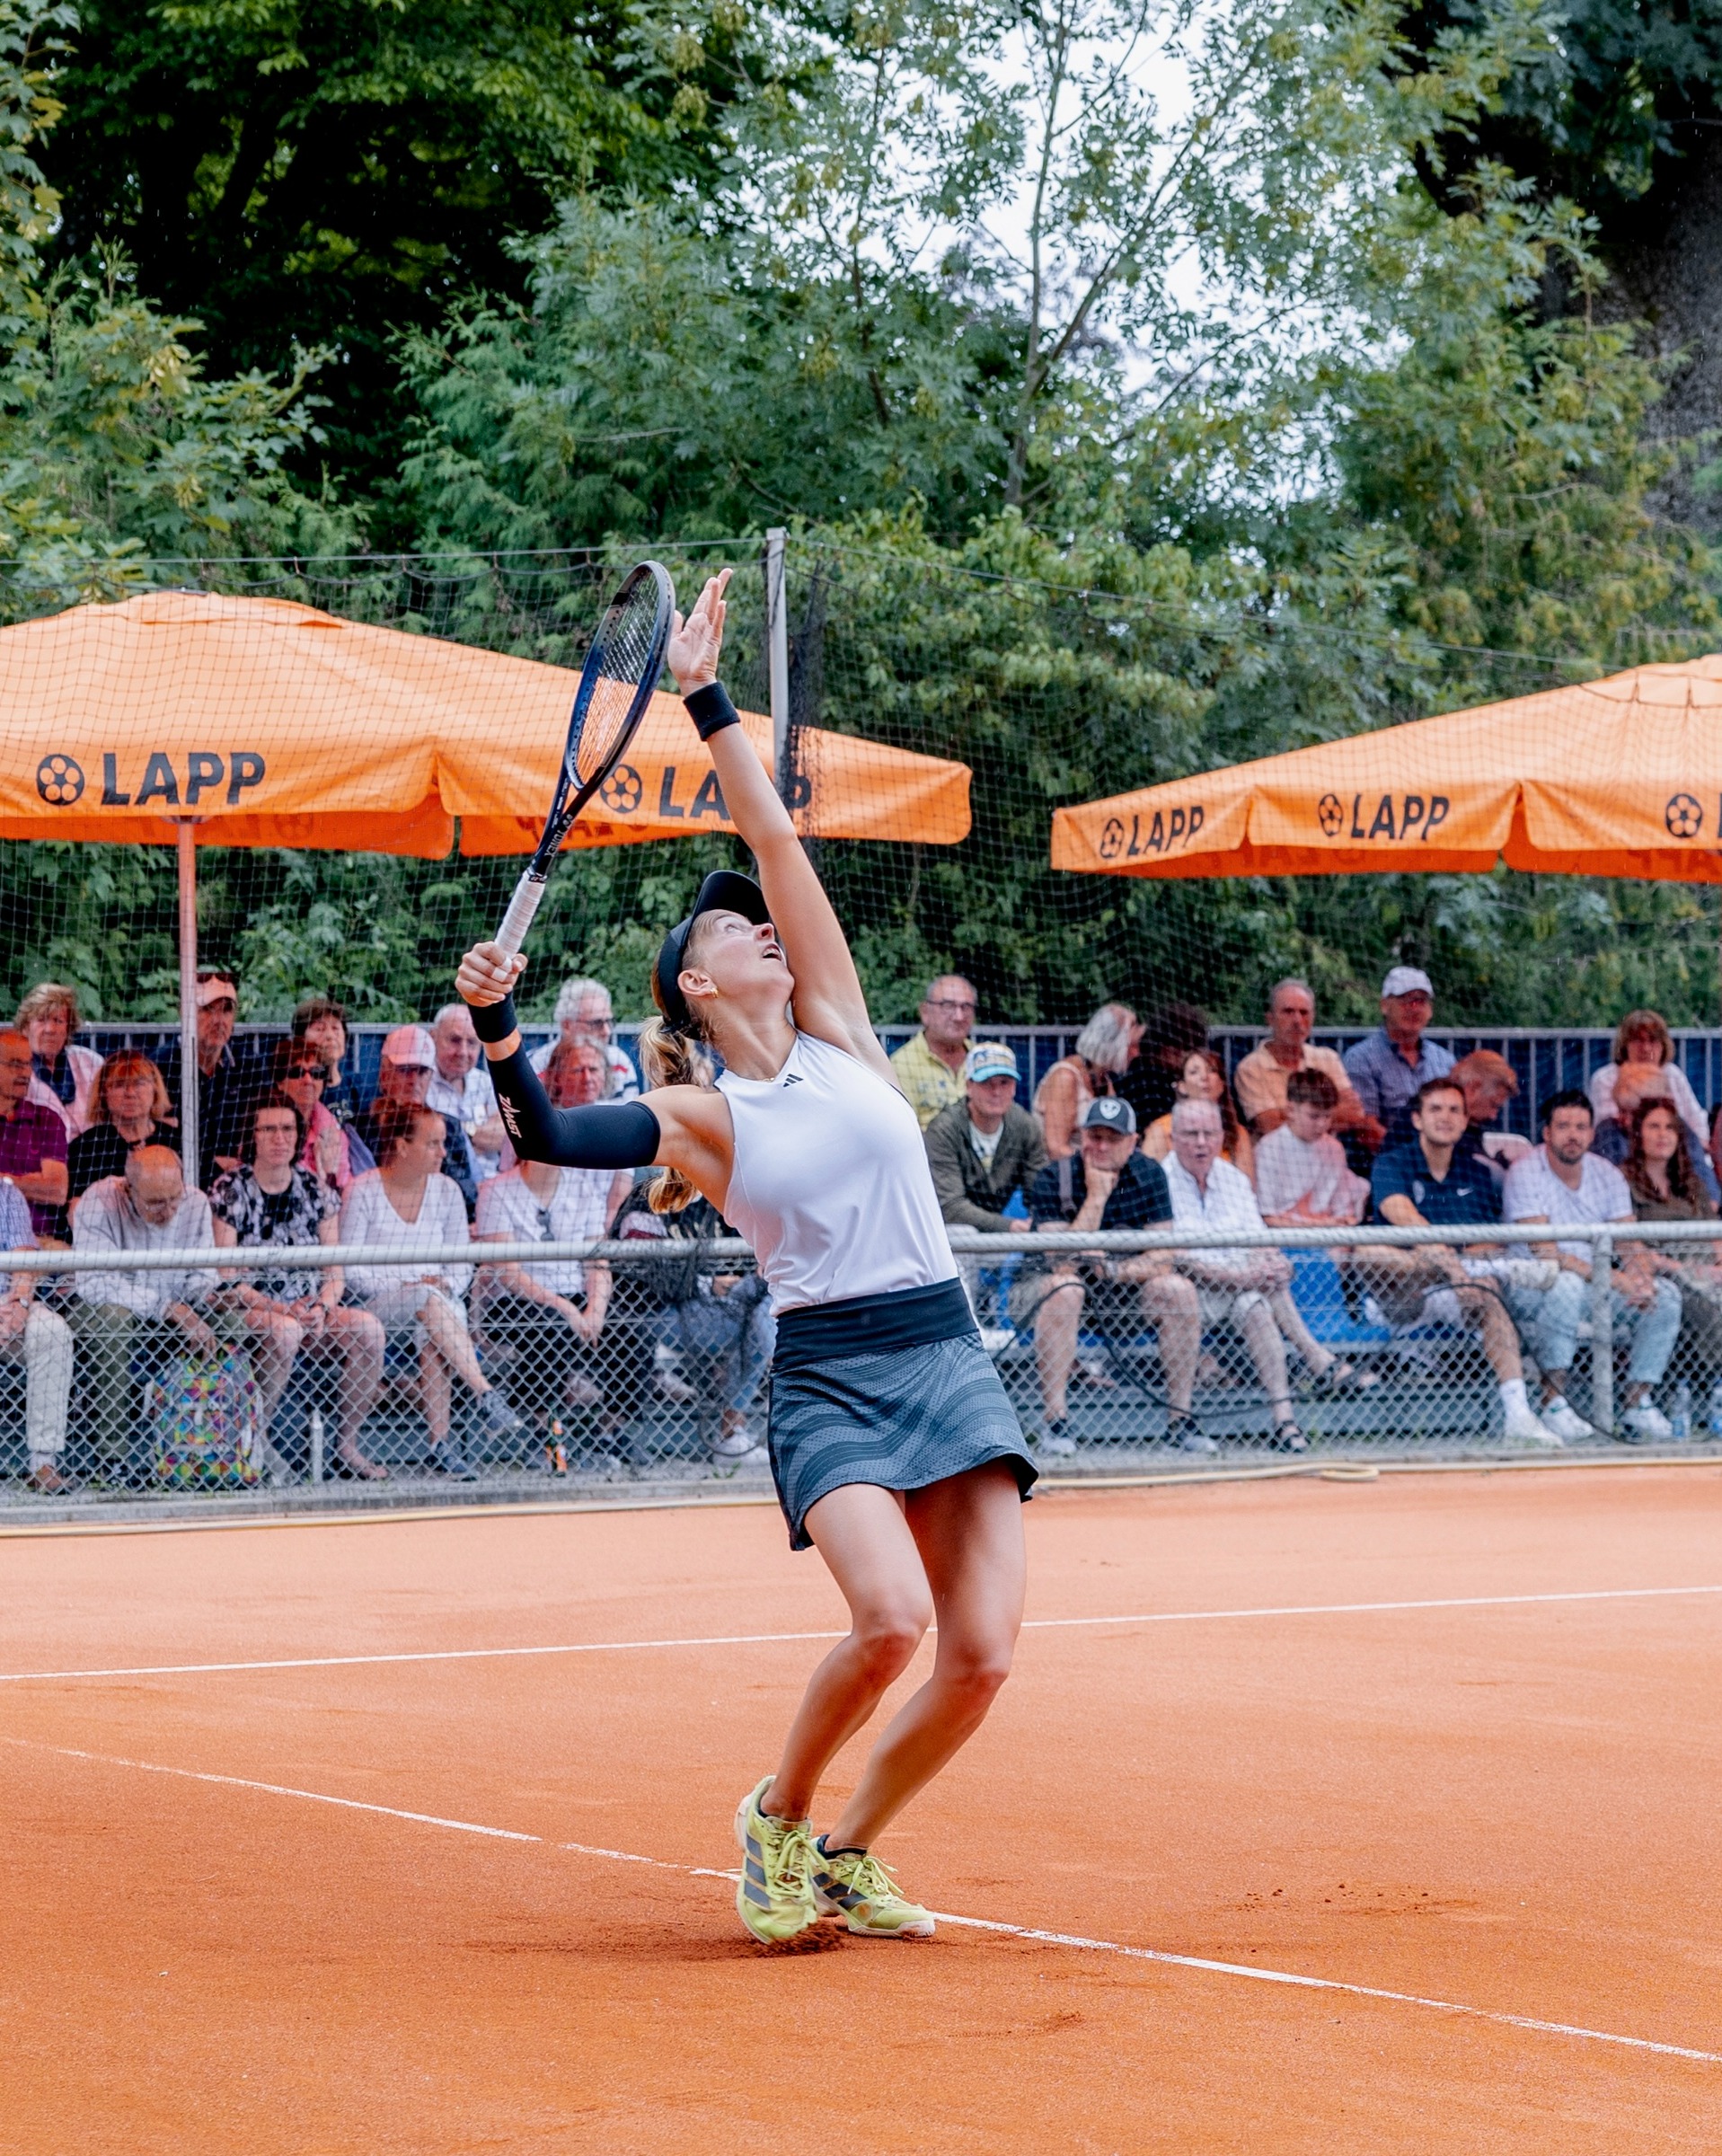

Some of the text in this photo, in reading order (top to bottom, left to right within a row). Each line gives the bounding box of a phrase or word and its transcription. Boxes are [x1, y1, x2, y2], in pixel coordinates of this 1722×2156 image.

[101, 752, 266, 806] LAPP
[659, 766, 812, 821] LAP
[1126, 806, 1205, 857] LAPP
[1350, 792, 1450, 841] LAPP
